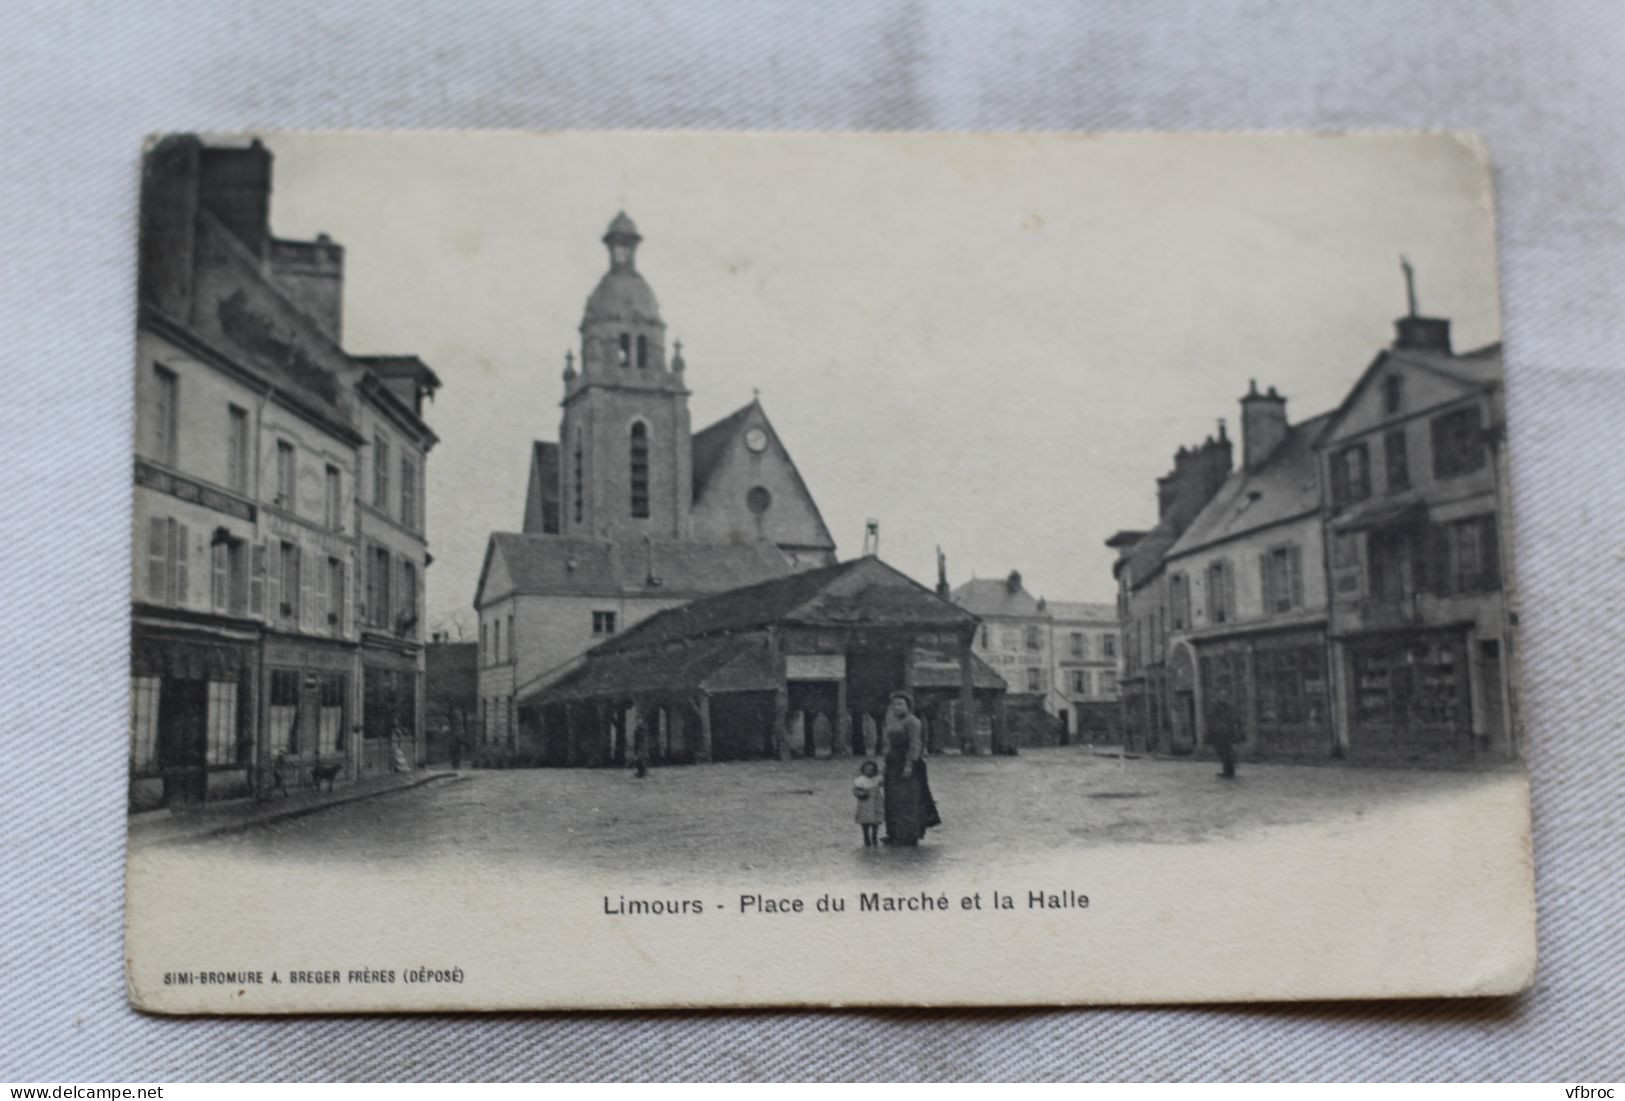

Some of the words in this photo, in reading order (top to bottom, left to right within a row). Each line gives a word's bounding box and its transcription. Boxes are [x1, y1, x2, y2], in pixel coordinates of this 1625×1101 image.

[603, 895, 704, 916] Limours
[739, 893, 805, 914] Place
[815, 893, 845, 913] du
[859, 891, 950, 913] Marché
[960, 892, 982, 911] et
[993, 890, 1015, 910] la
[1028, 889, 1090, 910] Halle
[163, 971, 263, 986] SIMI-BROMURE
[270, 971, 283, 984] A.
[289, 970, 341, 985] BREGER
[348, 966, 396, 984] FRÈRES
[403, 965, 465, 984] (DÉPOSÉ)
